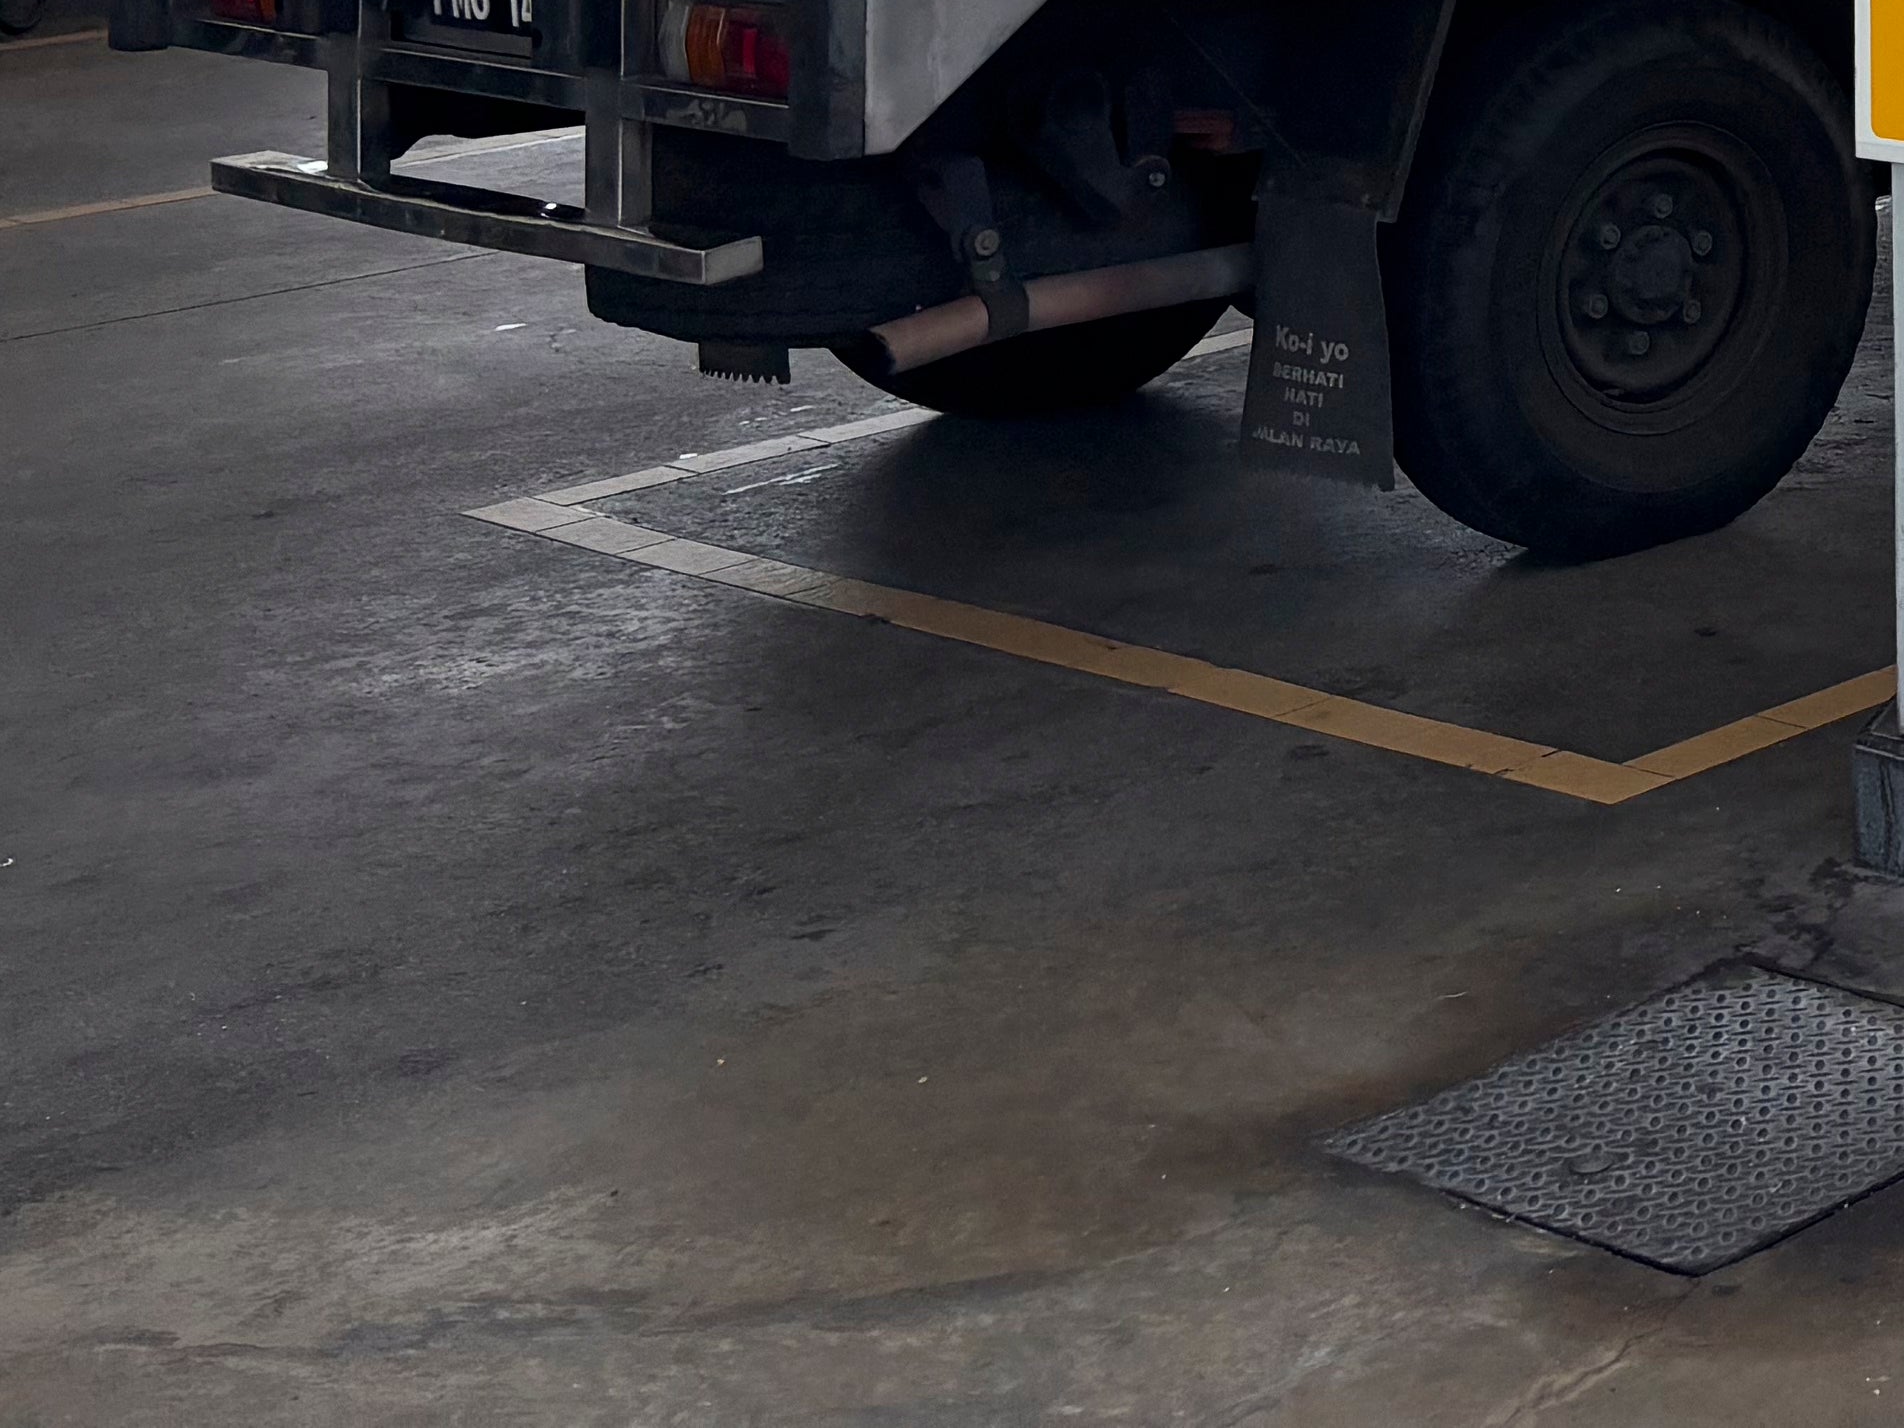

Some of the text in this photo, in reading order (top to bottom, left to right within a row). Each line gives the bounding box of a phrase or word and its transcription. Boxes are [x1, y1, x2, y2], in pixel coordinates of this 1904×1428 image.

[1273, 362, 1344, 388] BERHATI
[1283, 388, 1324, 408] HATI
[1292, 411, 1311, 427] DI
[1253, 427, 1361, 455] JALAN RAYA
